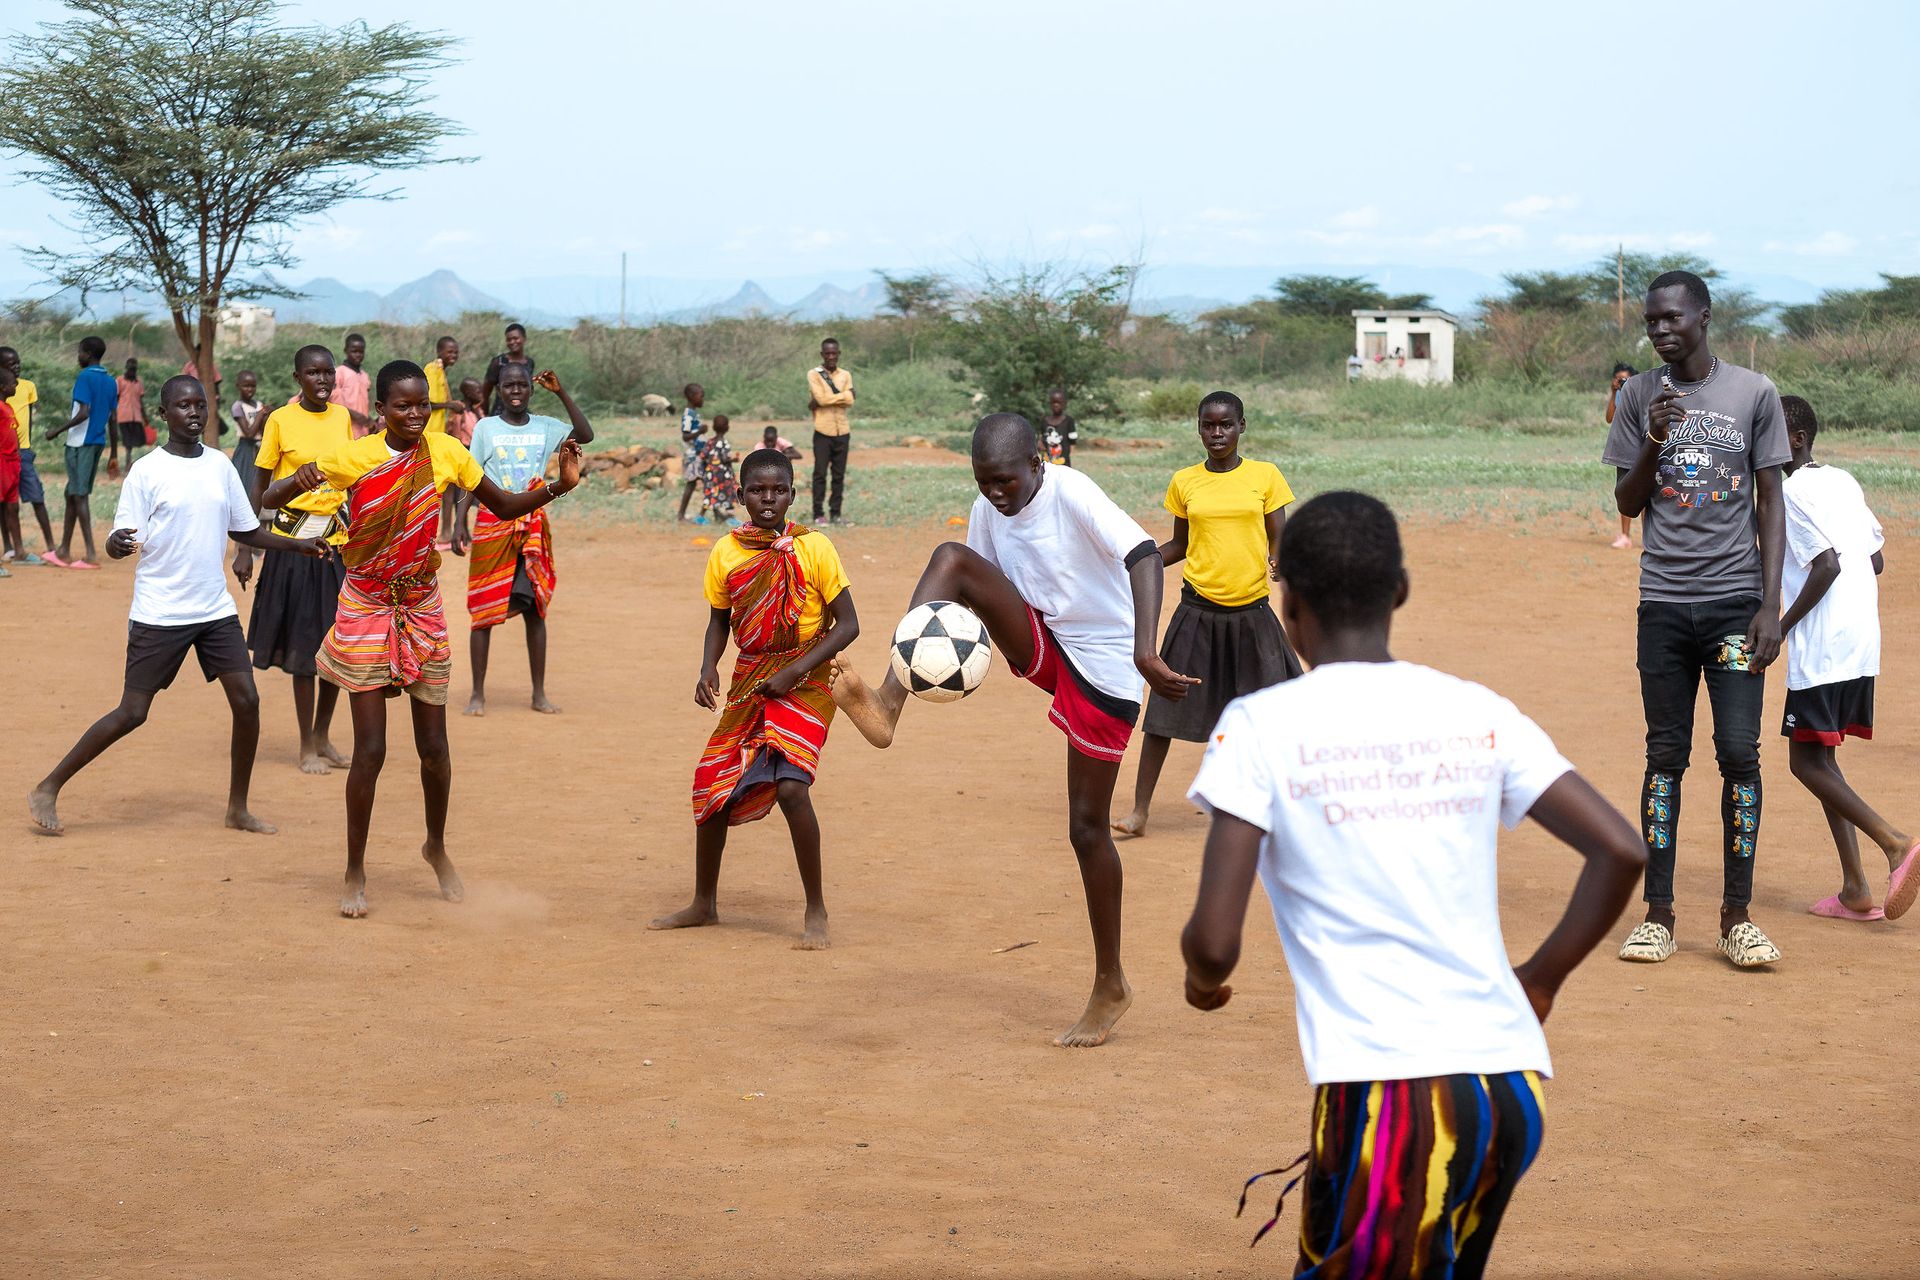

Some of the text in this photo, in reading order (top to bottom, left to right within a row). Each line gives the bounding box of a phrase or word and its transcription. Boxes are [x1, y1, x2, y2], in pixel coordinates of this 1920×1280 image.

[1708, 411, 1736, 423] COLLEGE
[1691, 416, 1744, 447] Series
[1673, 453, 1710, 467] CWS
[1731, 475, 1741, 491] F
[1680, 493, 1690, 503] V
[1712, 491, 1728, 502] U
[1298, 742, 1404, 766] Leaving
[1408, 737, 1442, 758] no
[1287, 769, 1381, 801] behind
[1387, 771, 1427, 790] for
